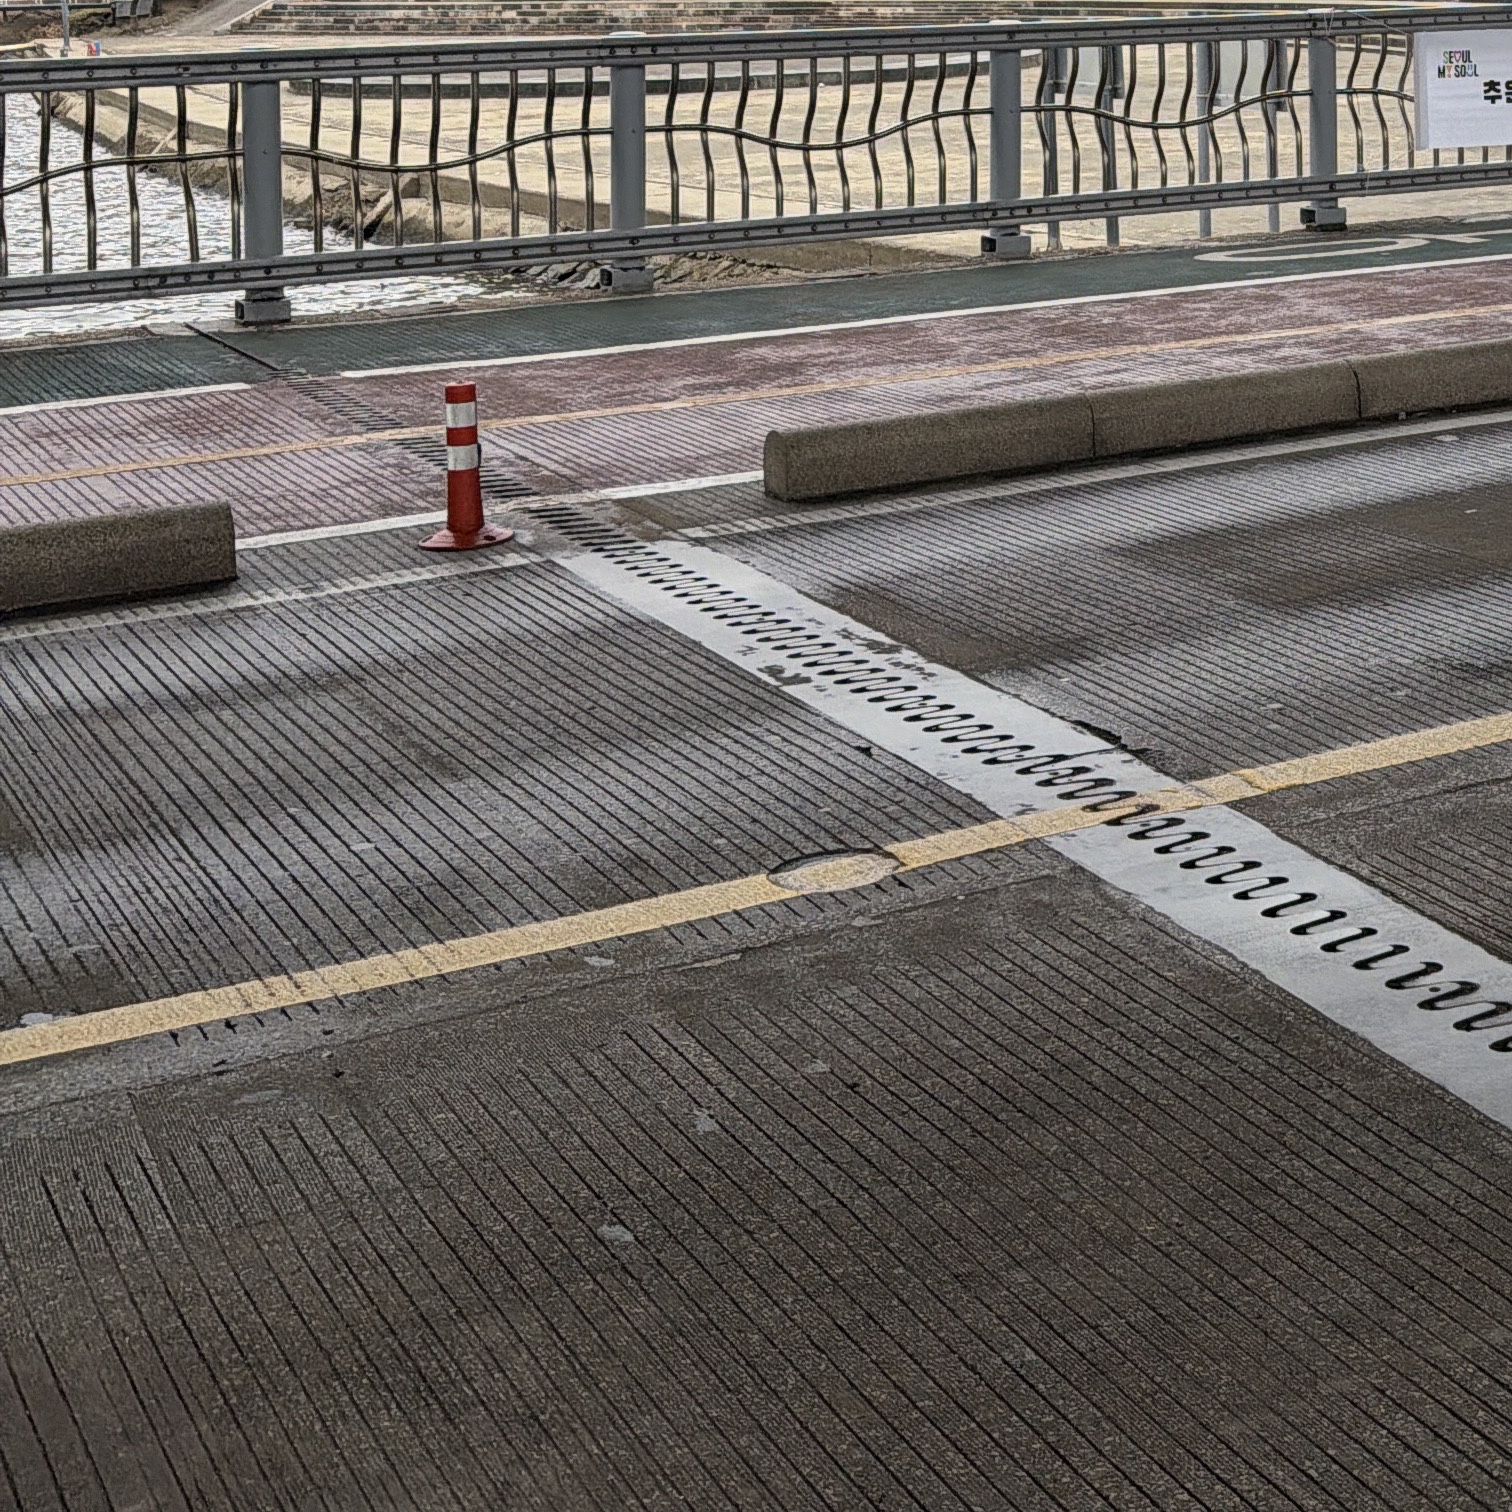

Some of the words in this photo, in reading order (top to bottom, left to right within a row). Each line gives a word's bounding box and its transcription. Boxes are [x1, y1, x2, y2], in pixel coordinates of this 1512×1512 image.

[1442, 49, 1473, 65] SEOUL
[1437, 64, 1453, 79] MY
[1454, 63, 1480, 78] SOUL
